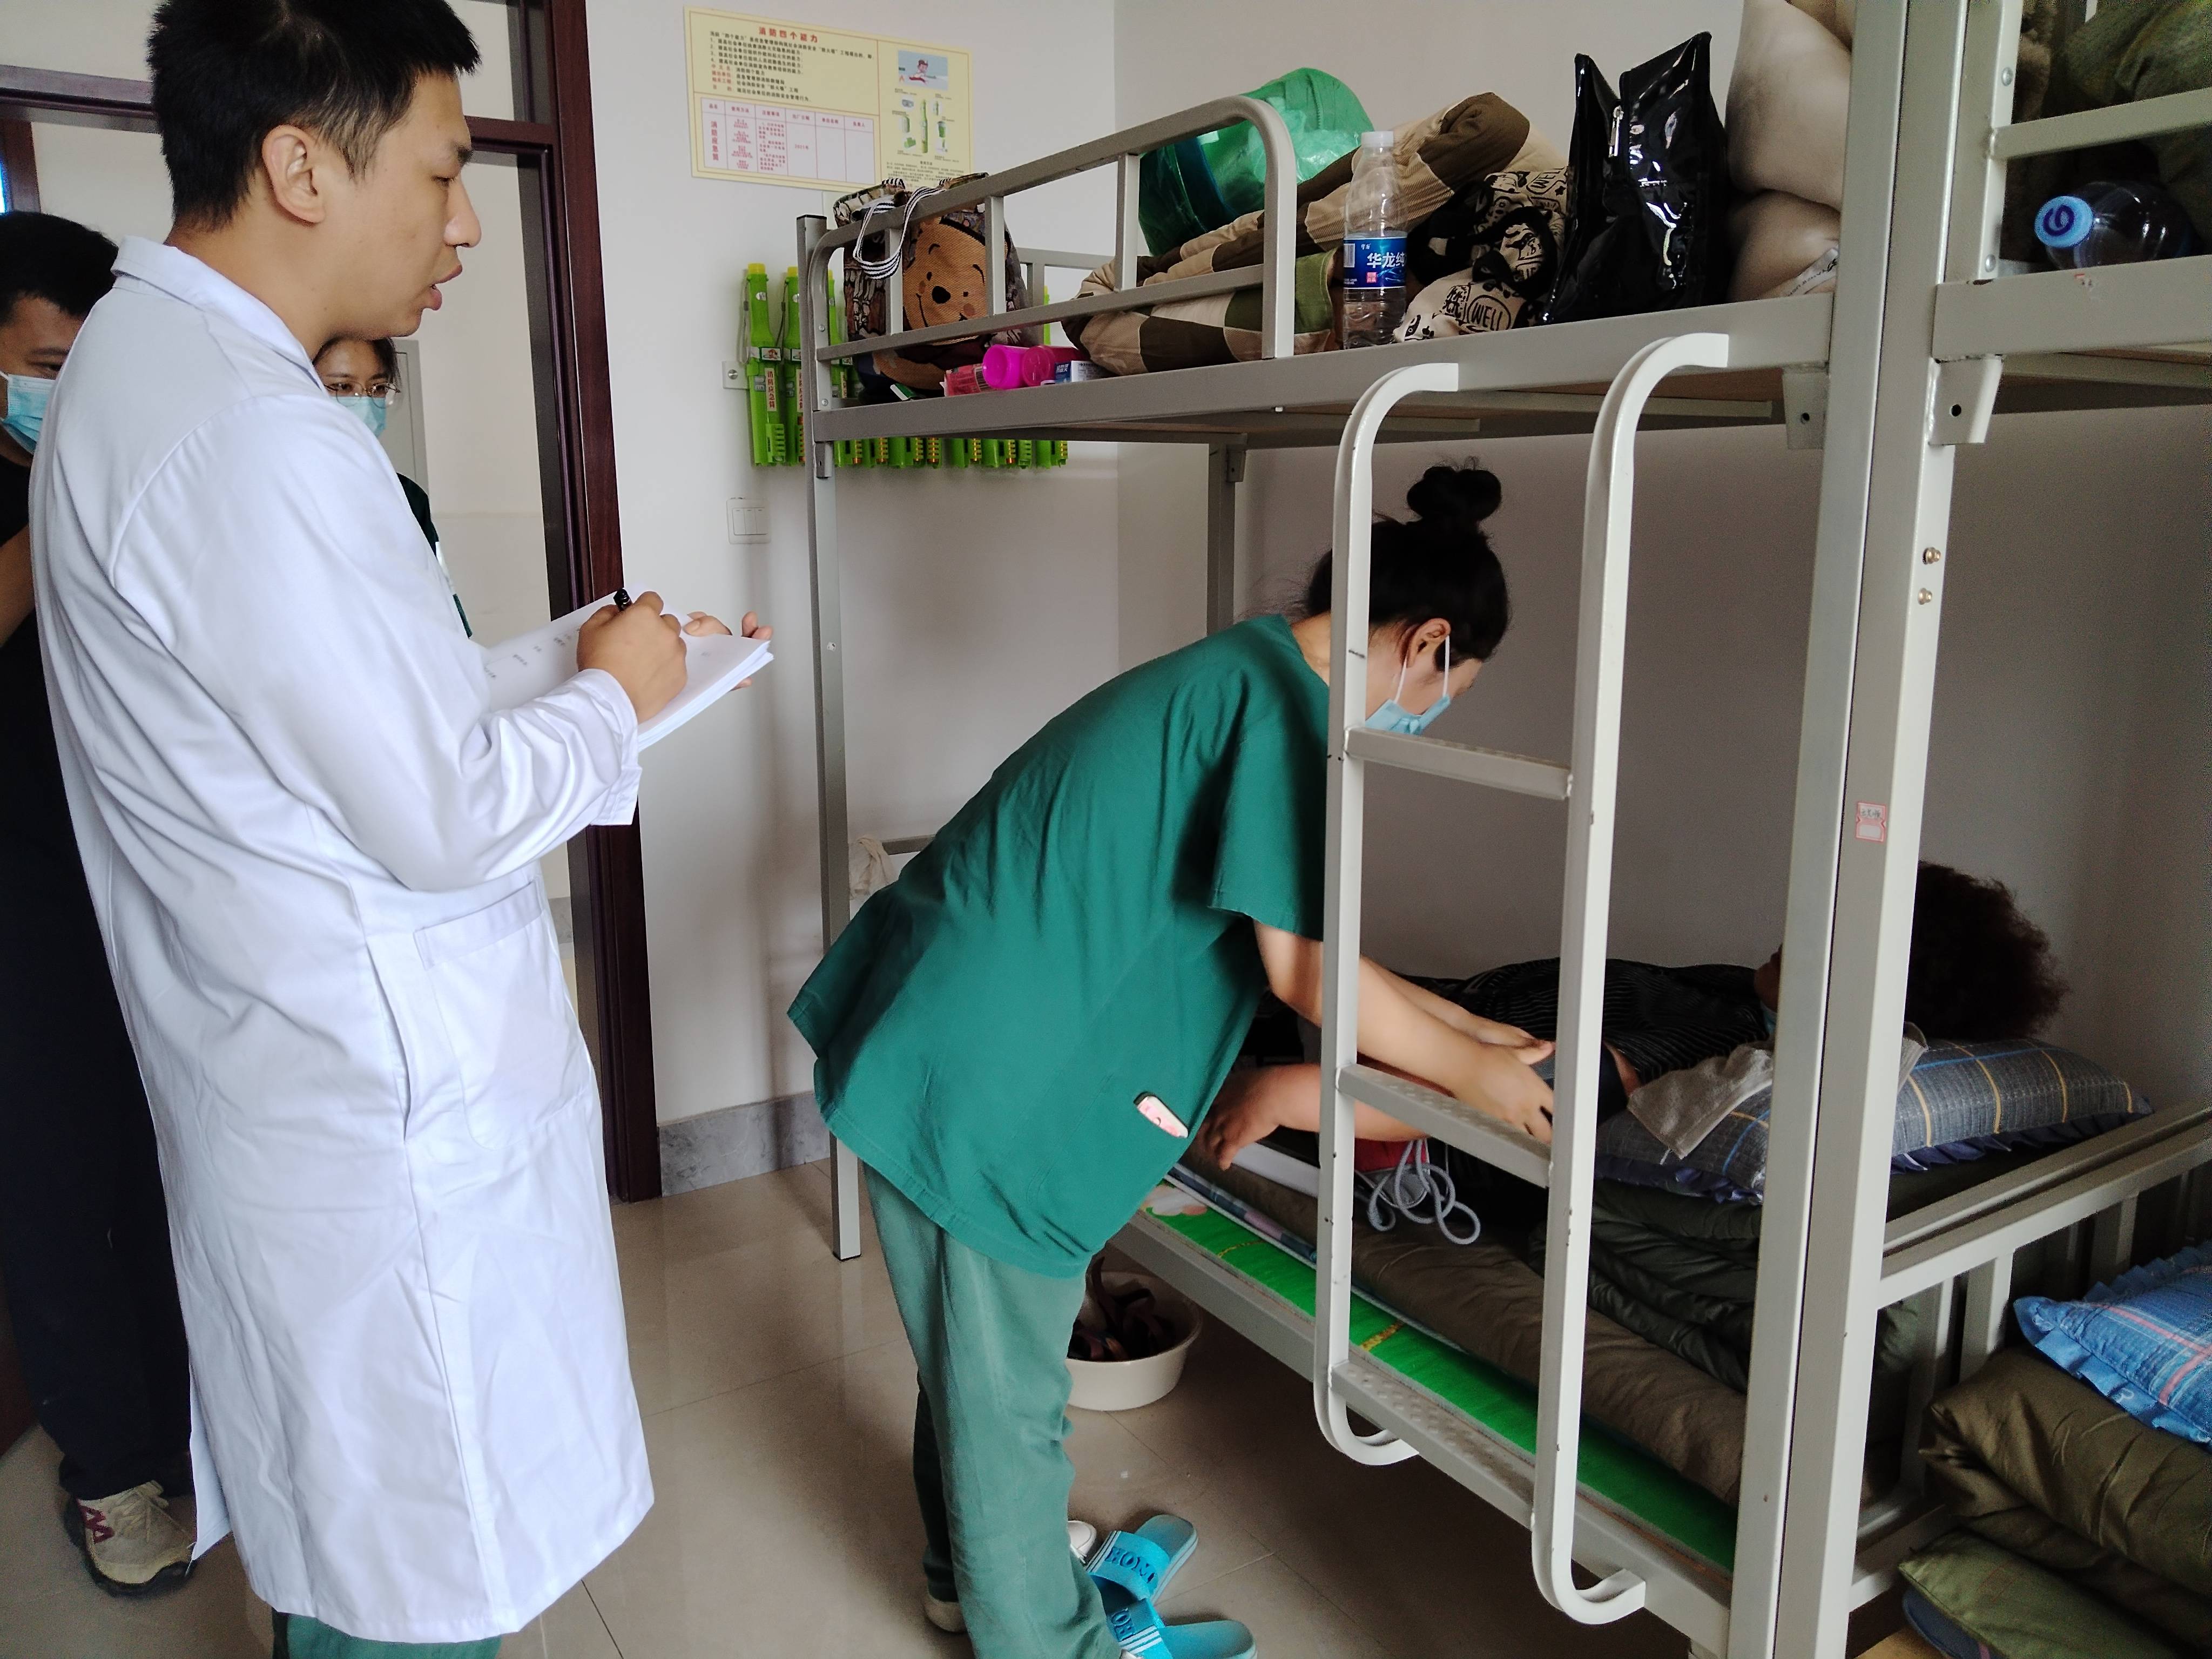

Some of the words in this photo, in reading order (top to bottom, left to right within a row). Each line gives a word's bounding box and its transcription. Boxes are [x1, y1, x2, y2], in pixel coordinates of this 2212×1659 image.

[759, 26, 818, 43] 消防四个能力
